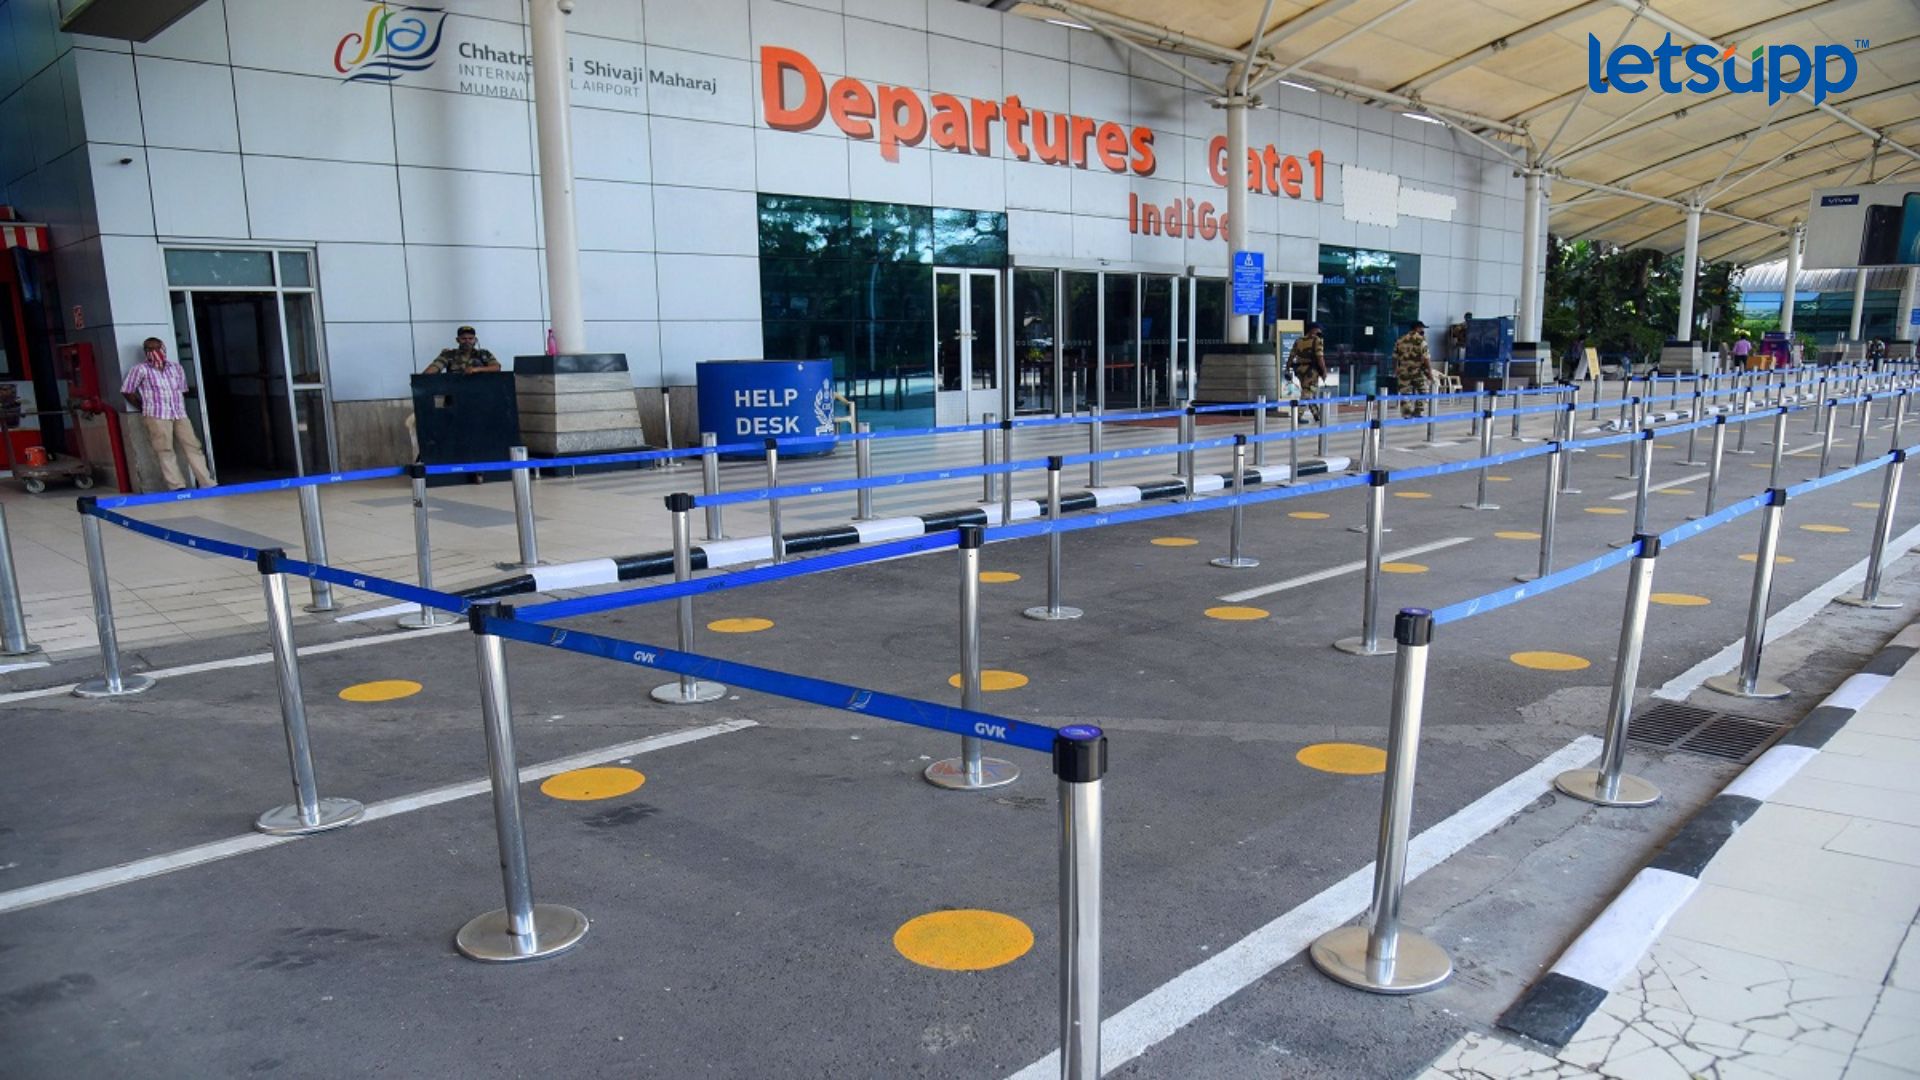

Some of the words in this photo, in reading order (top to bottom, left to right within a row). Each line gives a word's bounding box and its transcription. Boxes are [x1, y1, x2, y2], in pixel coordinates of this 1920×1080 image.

[584, 60, 643, 85] Shivaji
[650, 69, 716, 95] Maharaj
[460, 82, 524, 100] MUMBAI
[583, 80, 640, 98] AIRPORT
[760, 45, 1157, 177] Departures
[1208, 135, 1303, 199] Gate
[1308, 149, 1325, 203] 1
[735, 388, 799, 408] HELP
[736, 416, 801, 436] DESK
[634, 650, 657, 664] GVK
[974, 721, 1007, 740] GVK
